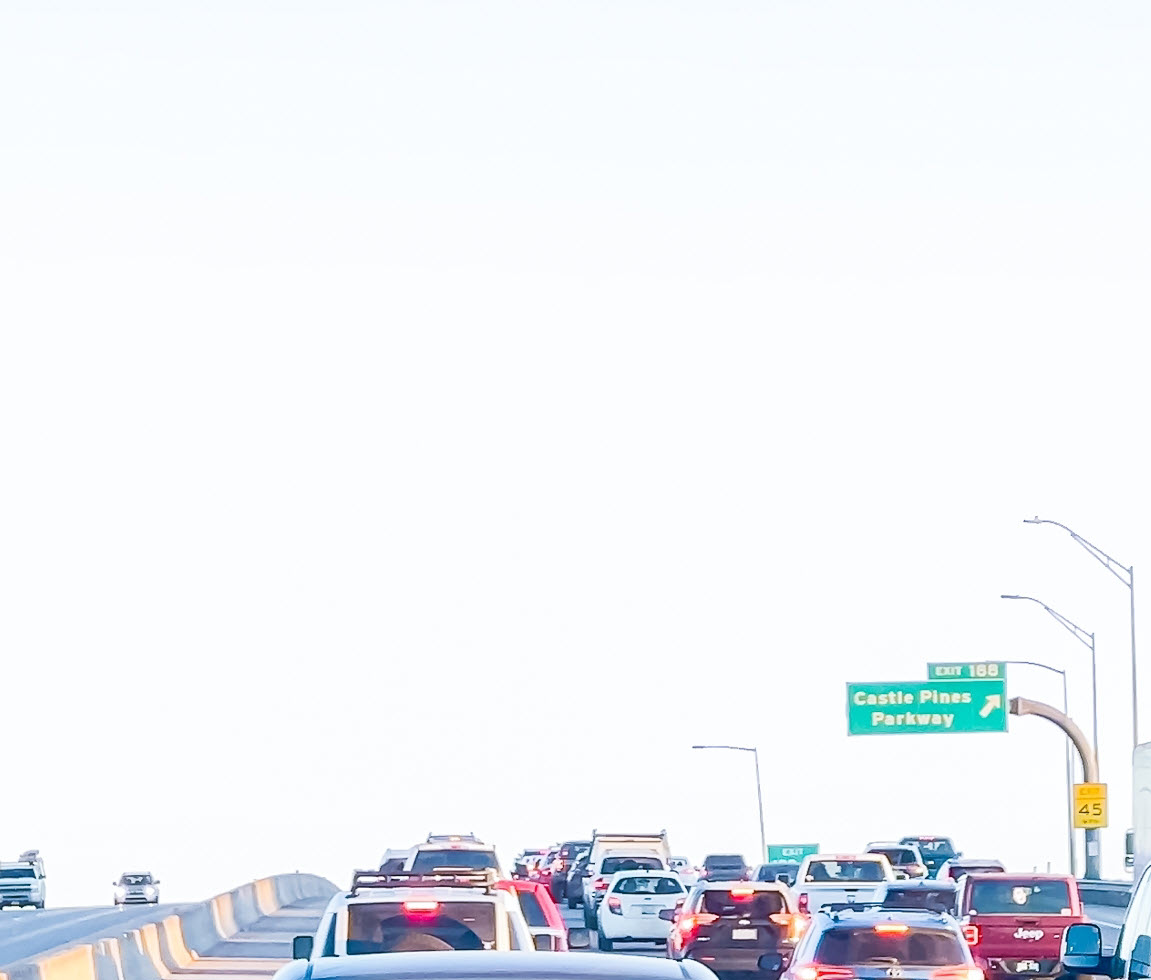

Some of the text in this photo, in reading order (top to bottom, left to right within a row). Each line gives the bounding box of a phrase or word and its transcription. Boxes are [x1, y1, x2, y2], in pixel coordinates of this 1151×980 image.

[935, 663, 999, 677] EXIT 188
[853, 690, 972, 705] Castle Pines
[871, 711, 954, 728] Parkway
[1078, 803, 1102, 816] 45
[1013, 927, 1044, 940] Jeep
